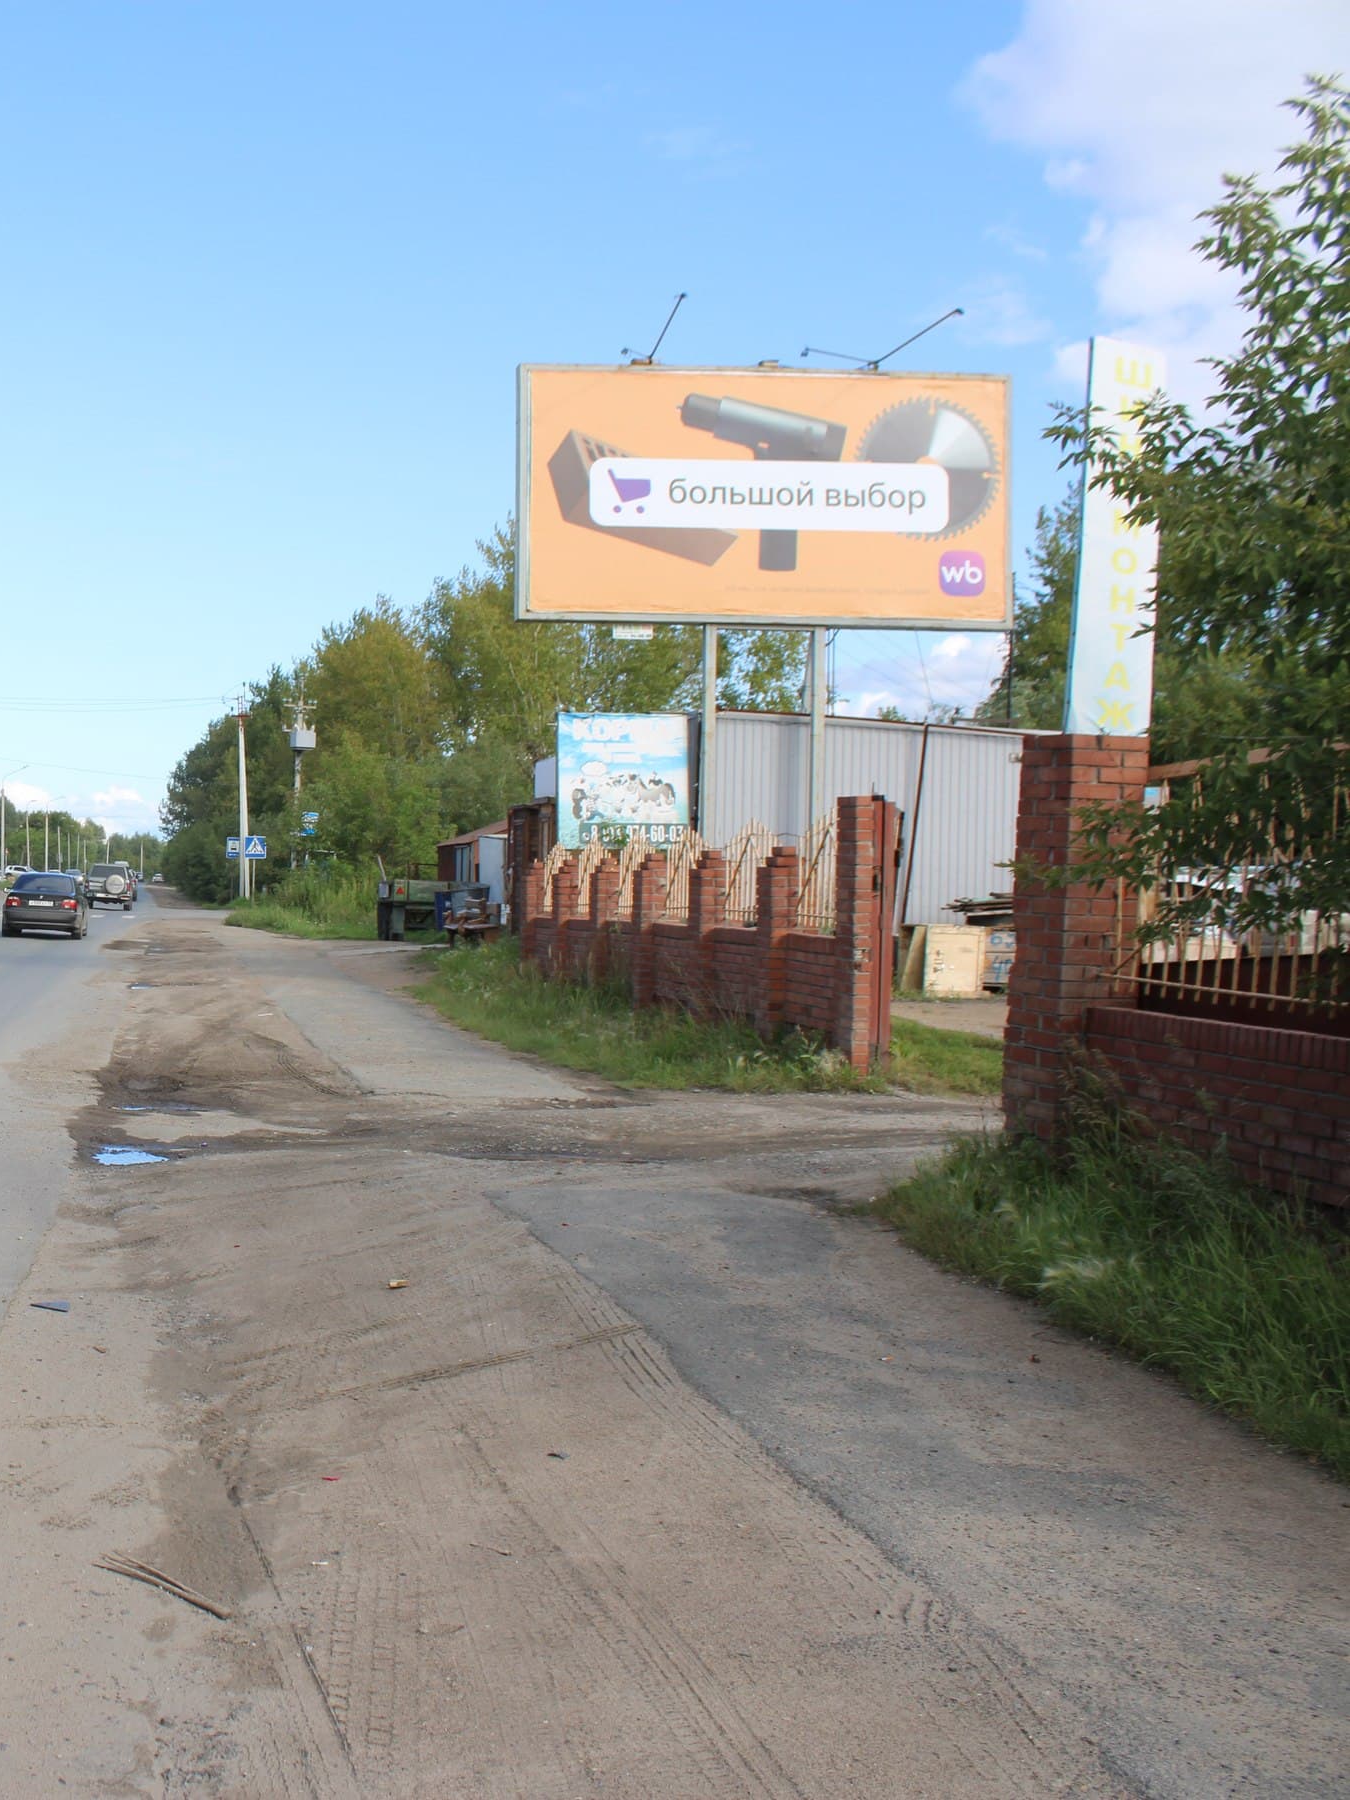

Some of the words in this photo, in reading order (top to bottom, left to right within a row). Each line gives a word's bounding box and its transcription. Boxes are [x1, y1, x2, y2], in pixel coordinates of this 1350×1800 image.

[668, 478, 815, 507] большой
[824, 481, 927, 515] выбор
[941, 559, 983, 585] wb
